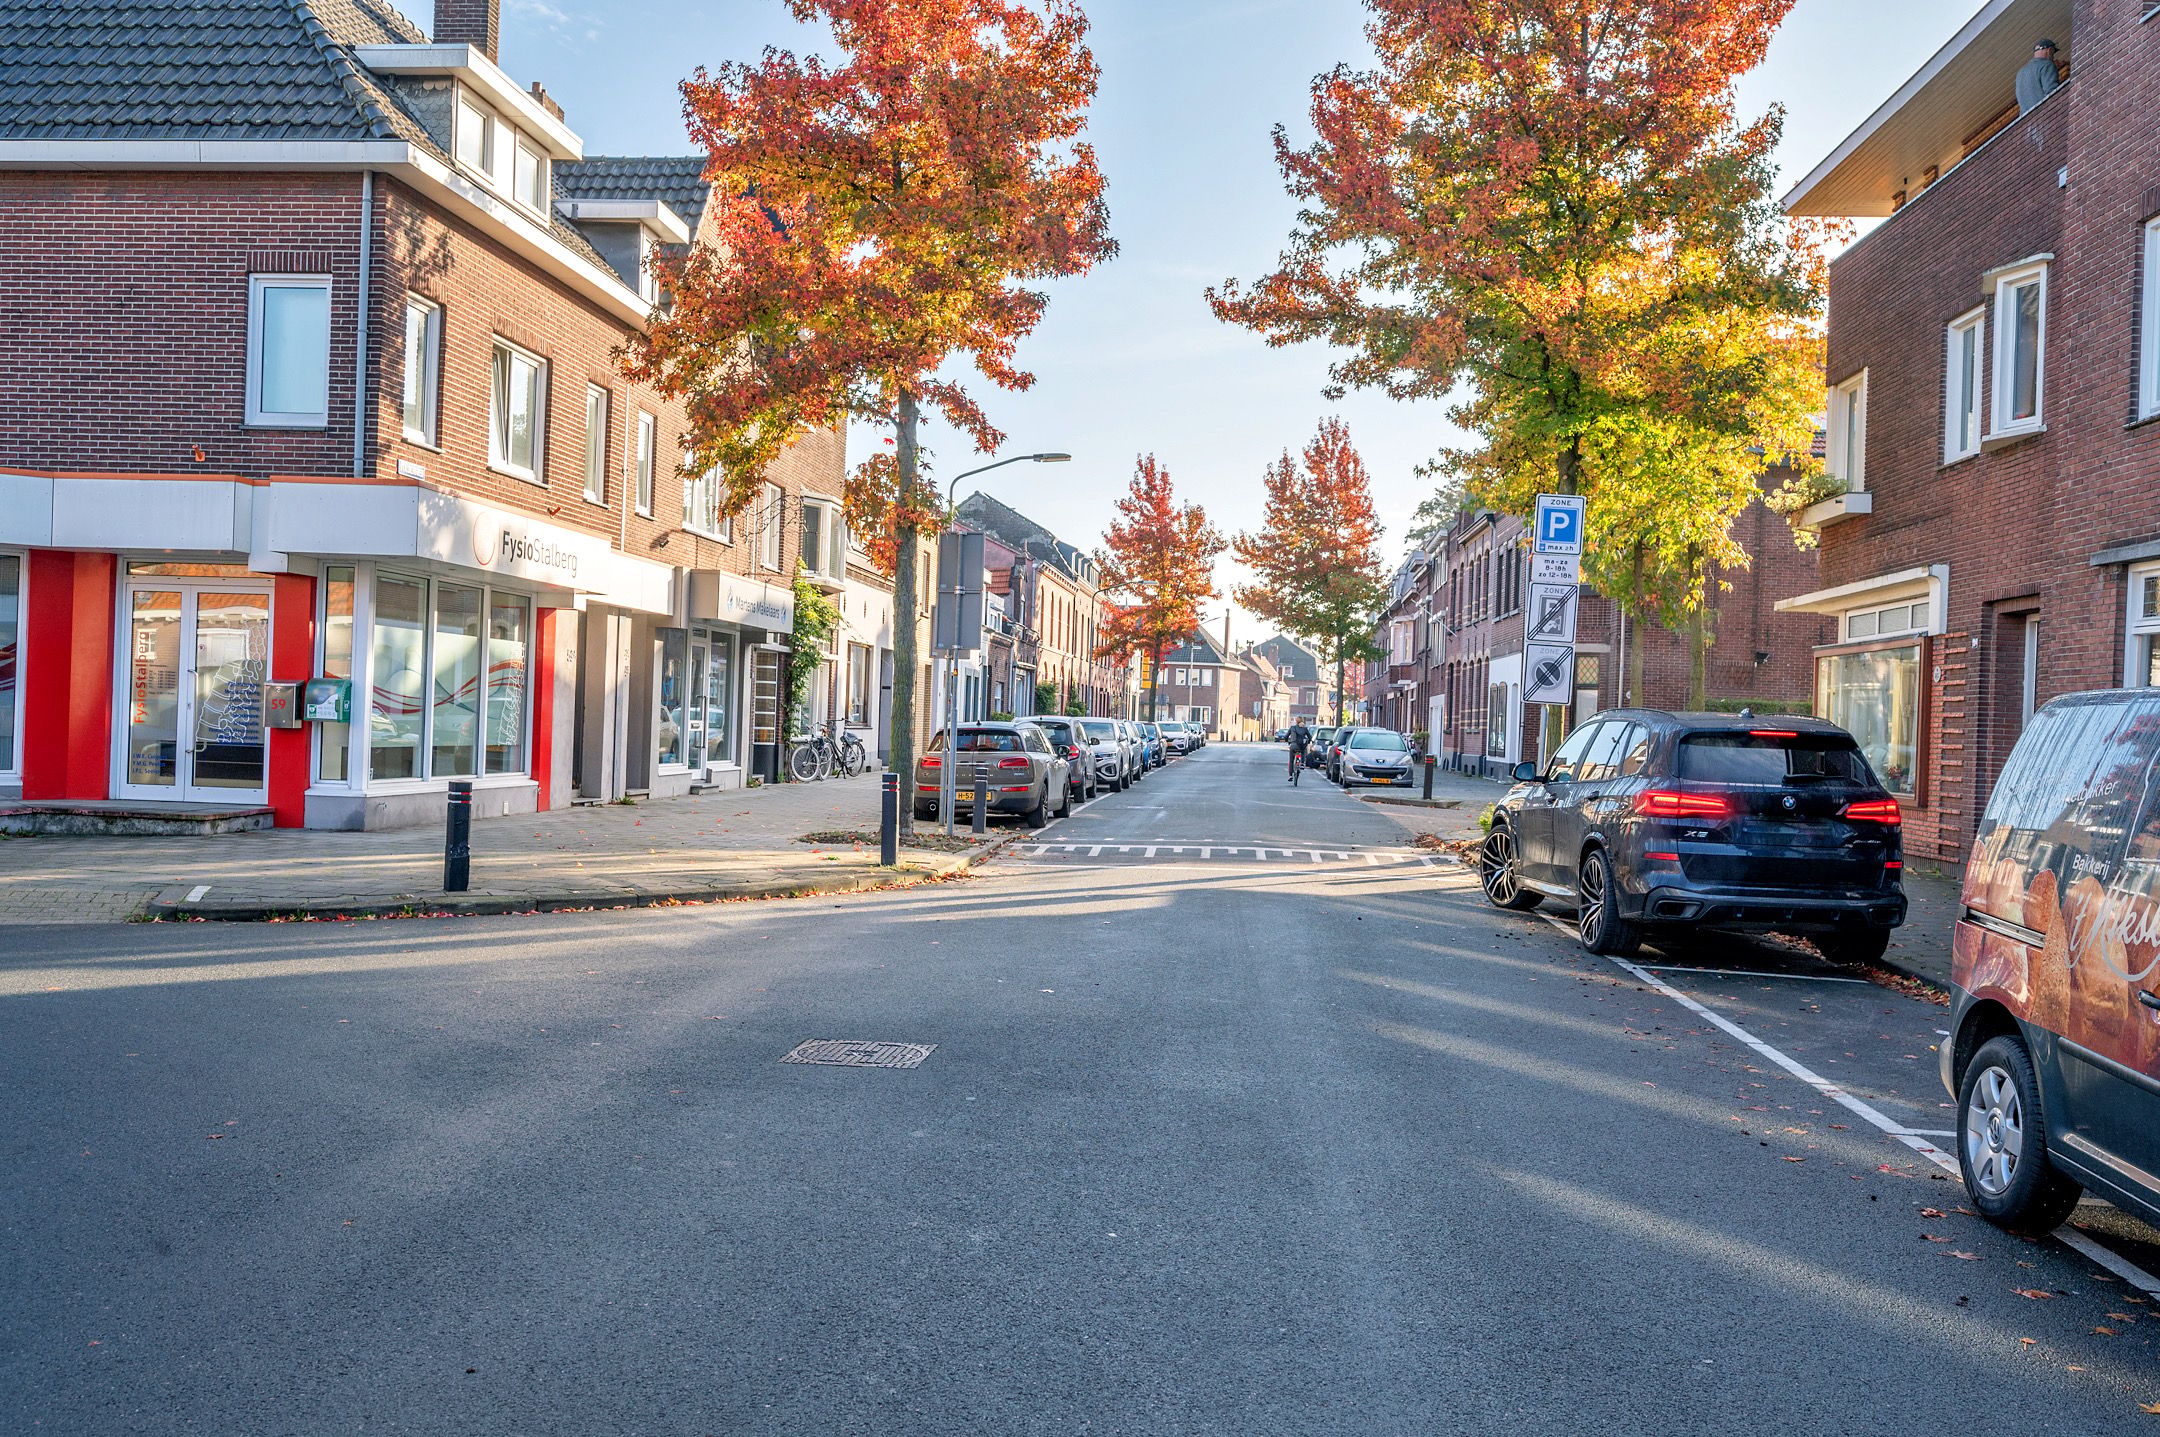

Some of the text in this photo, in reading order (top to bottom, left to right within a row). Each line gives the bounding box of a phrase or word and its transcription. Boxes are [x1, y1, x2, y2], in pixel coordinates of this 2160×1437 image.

[1549, 511, 1569, 538] P
[502, 530, 578, 578] FysioStalberg
[1548, 571, 1572, 579] 12-18h
[1543, 587, 1565, 595] ZONE
[756, 601, 780, 619] Makelaars
[1539, 647, 1560, 655] ZONE
[133, 632, 149, 724] FysioStalberg
[271, 698, 286, 710] 59
[2072, 854, 2111, 881] Bakkerij
